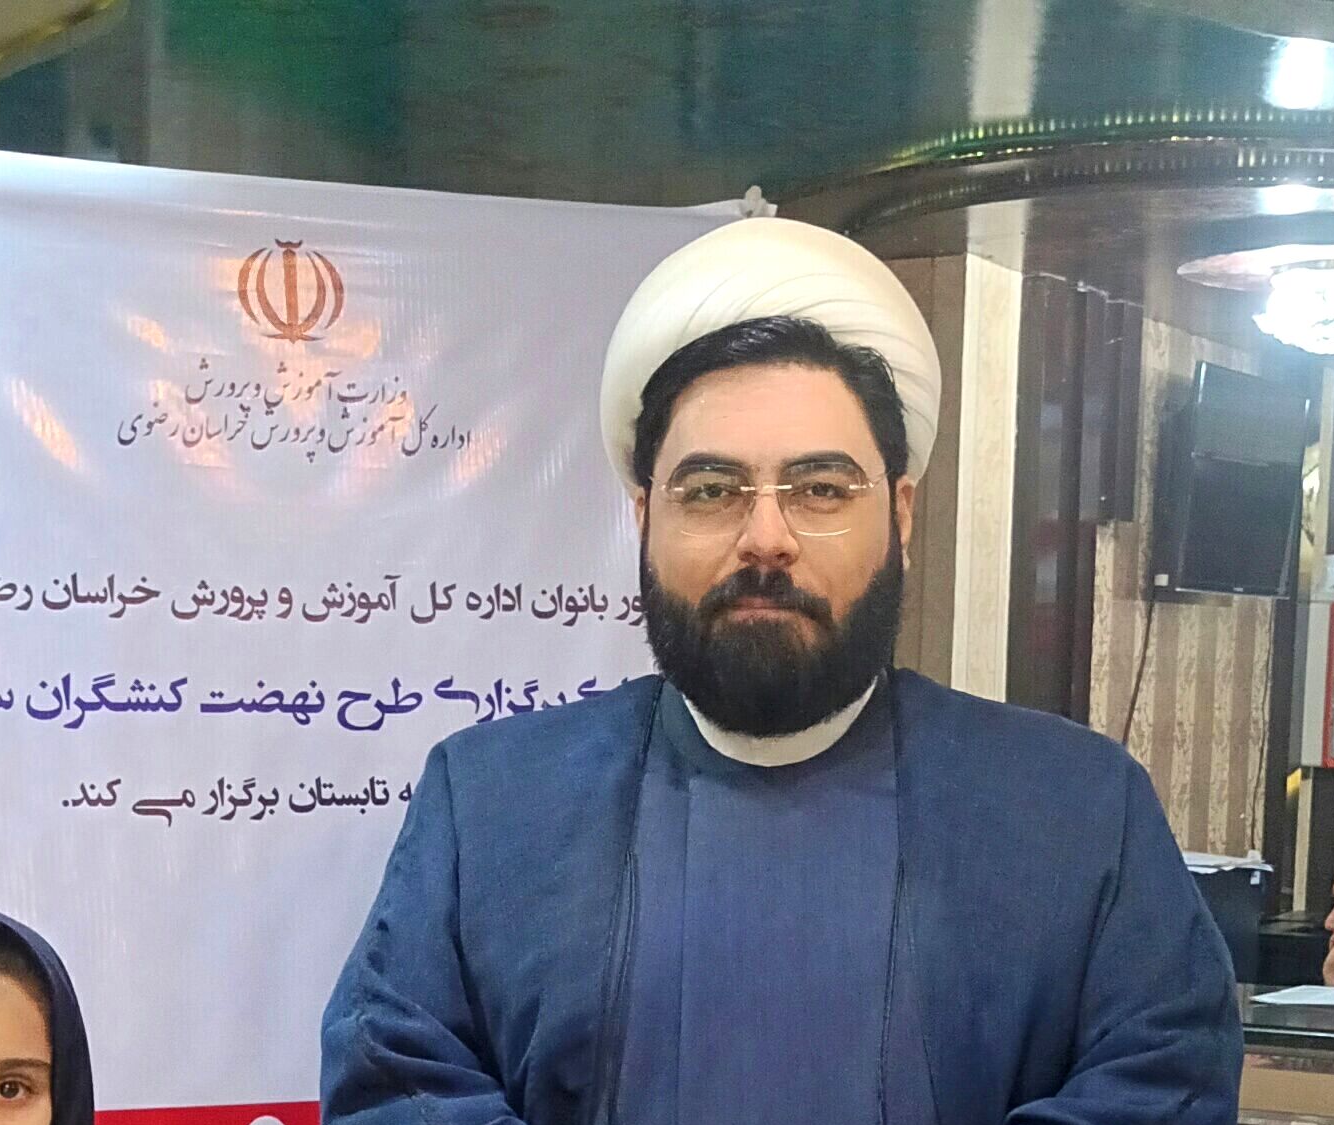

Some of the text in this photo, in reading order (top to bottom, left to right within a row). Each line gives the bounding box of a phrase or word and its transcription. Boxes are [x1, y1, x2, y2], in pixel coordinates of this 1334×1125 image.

[184, 358, 408, 411] وزارت آموزش و پرورش
[117, 402, 472, 463] اداره کل آموزش و پرورش خراسان رضوی
[42, 572, 161, 618] خراسان
[171, 580, 268, 621] پرورش
[276, 586, 293, 619] و
[302, 574, 402, 624] آموزش
[411, 581, 456, 624] کل
[466, 582, 522, 620] اداره
[531, 584, 609, 627] بانوان
[26, 673, 188, 729] کنشگران
[200, 679, 325, 726] نهضت
[337, 677, 423, 731] طرح
[62, 778, 122, 808] کند.
[132, 788, 196, 828] می
[202, 776, 280, 820] برگزار
[288, 776, 390, 814] تابستان
